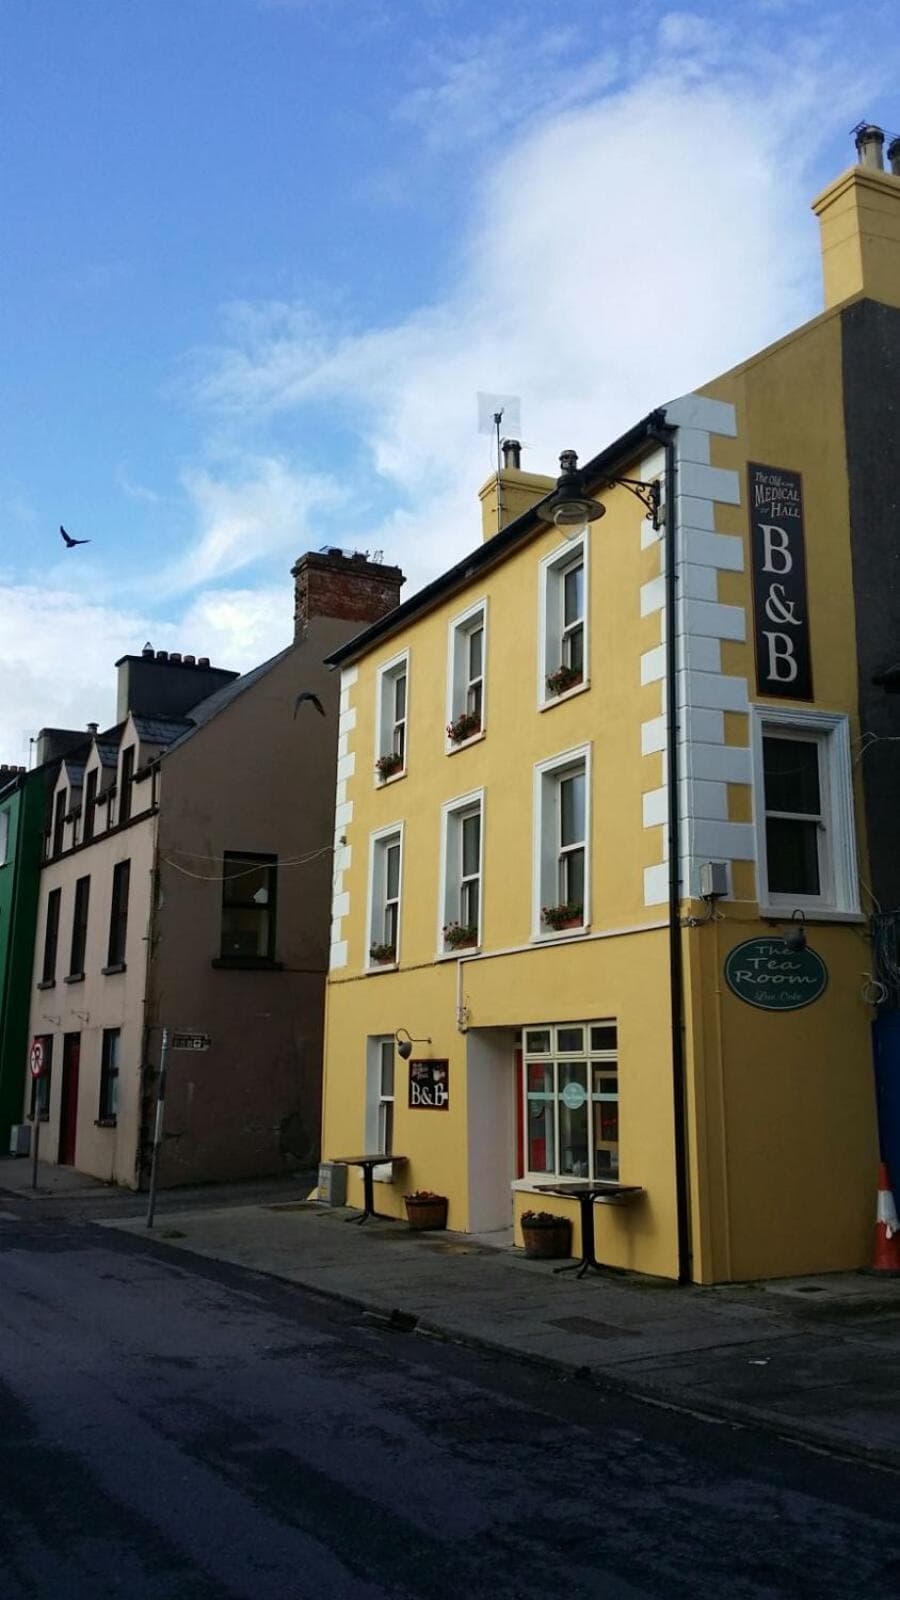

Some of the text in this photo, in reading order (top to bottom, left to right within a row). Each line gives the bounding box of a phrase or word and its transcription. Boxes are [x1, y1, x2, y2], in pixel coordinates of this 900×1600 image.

[755, 471, 768, 484] The
[754, 484, 800, 507] MEDICAL
[771, 501, 801, 518] HALL
[752, 944, 796, 955] The
[745, 957, 801, 970] Tea
[734, 970, 818, 984] Room
[411, 1080, 446, 1106] B&B
